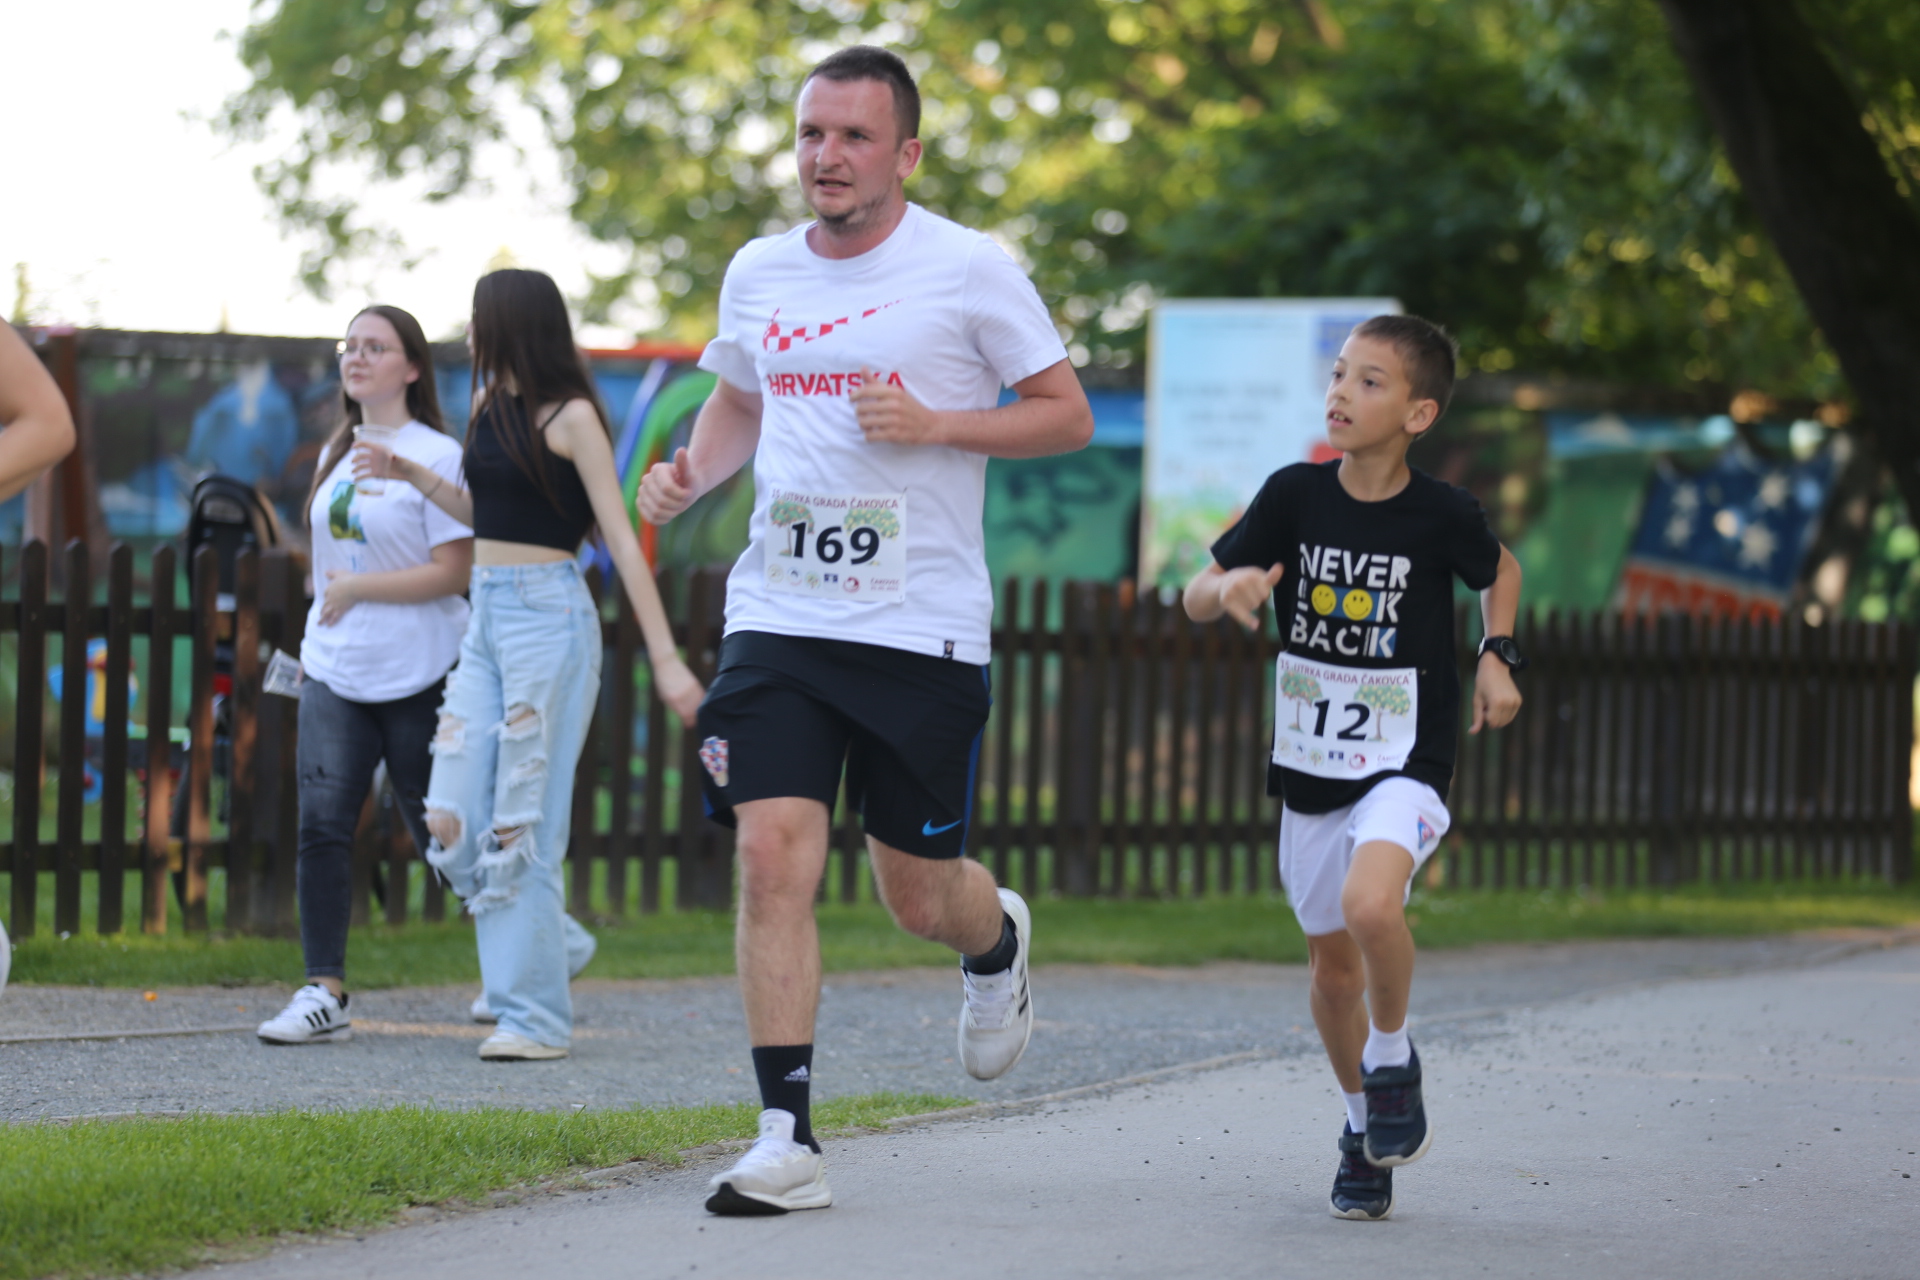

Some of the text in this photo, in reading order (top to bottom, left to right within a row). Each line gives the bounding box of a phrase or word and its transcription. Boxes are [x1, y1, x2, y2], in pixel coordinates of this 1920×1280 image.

[784, 491, 811, 505] UTRKA
[813, 496, 848, 509] GRADA
[850, 497, 899, 509] ČAKOVCA
[791, 521, 880, 565] 169
[1299, 543, 1412, 590] NEVER
[1290, 612, 1397, 659] BACK
[1293, 663, 1321, 679] UTRKA
[1323, 669, 1359, 685] GRADA
[1361, 672, 1410, 685] ČAKOVCA
[1313, 698, 1371, 741] 12
